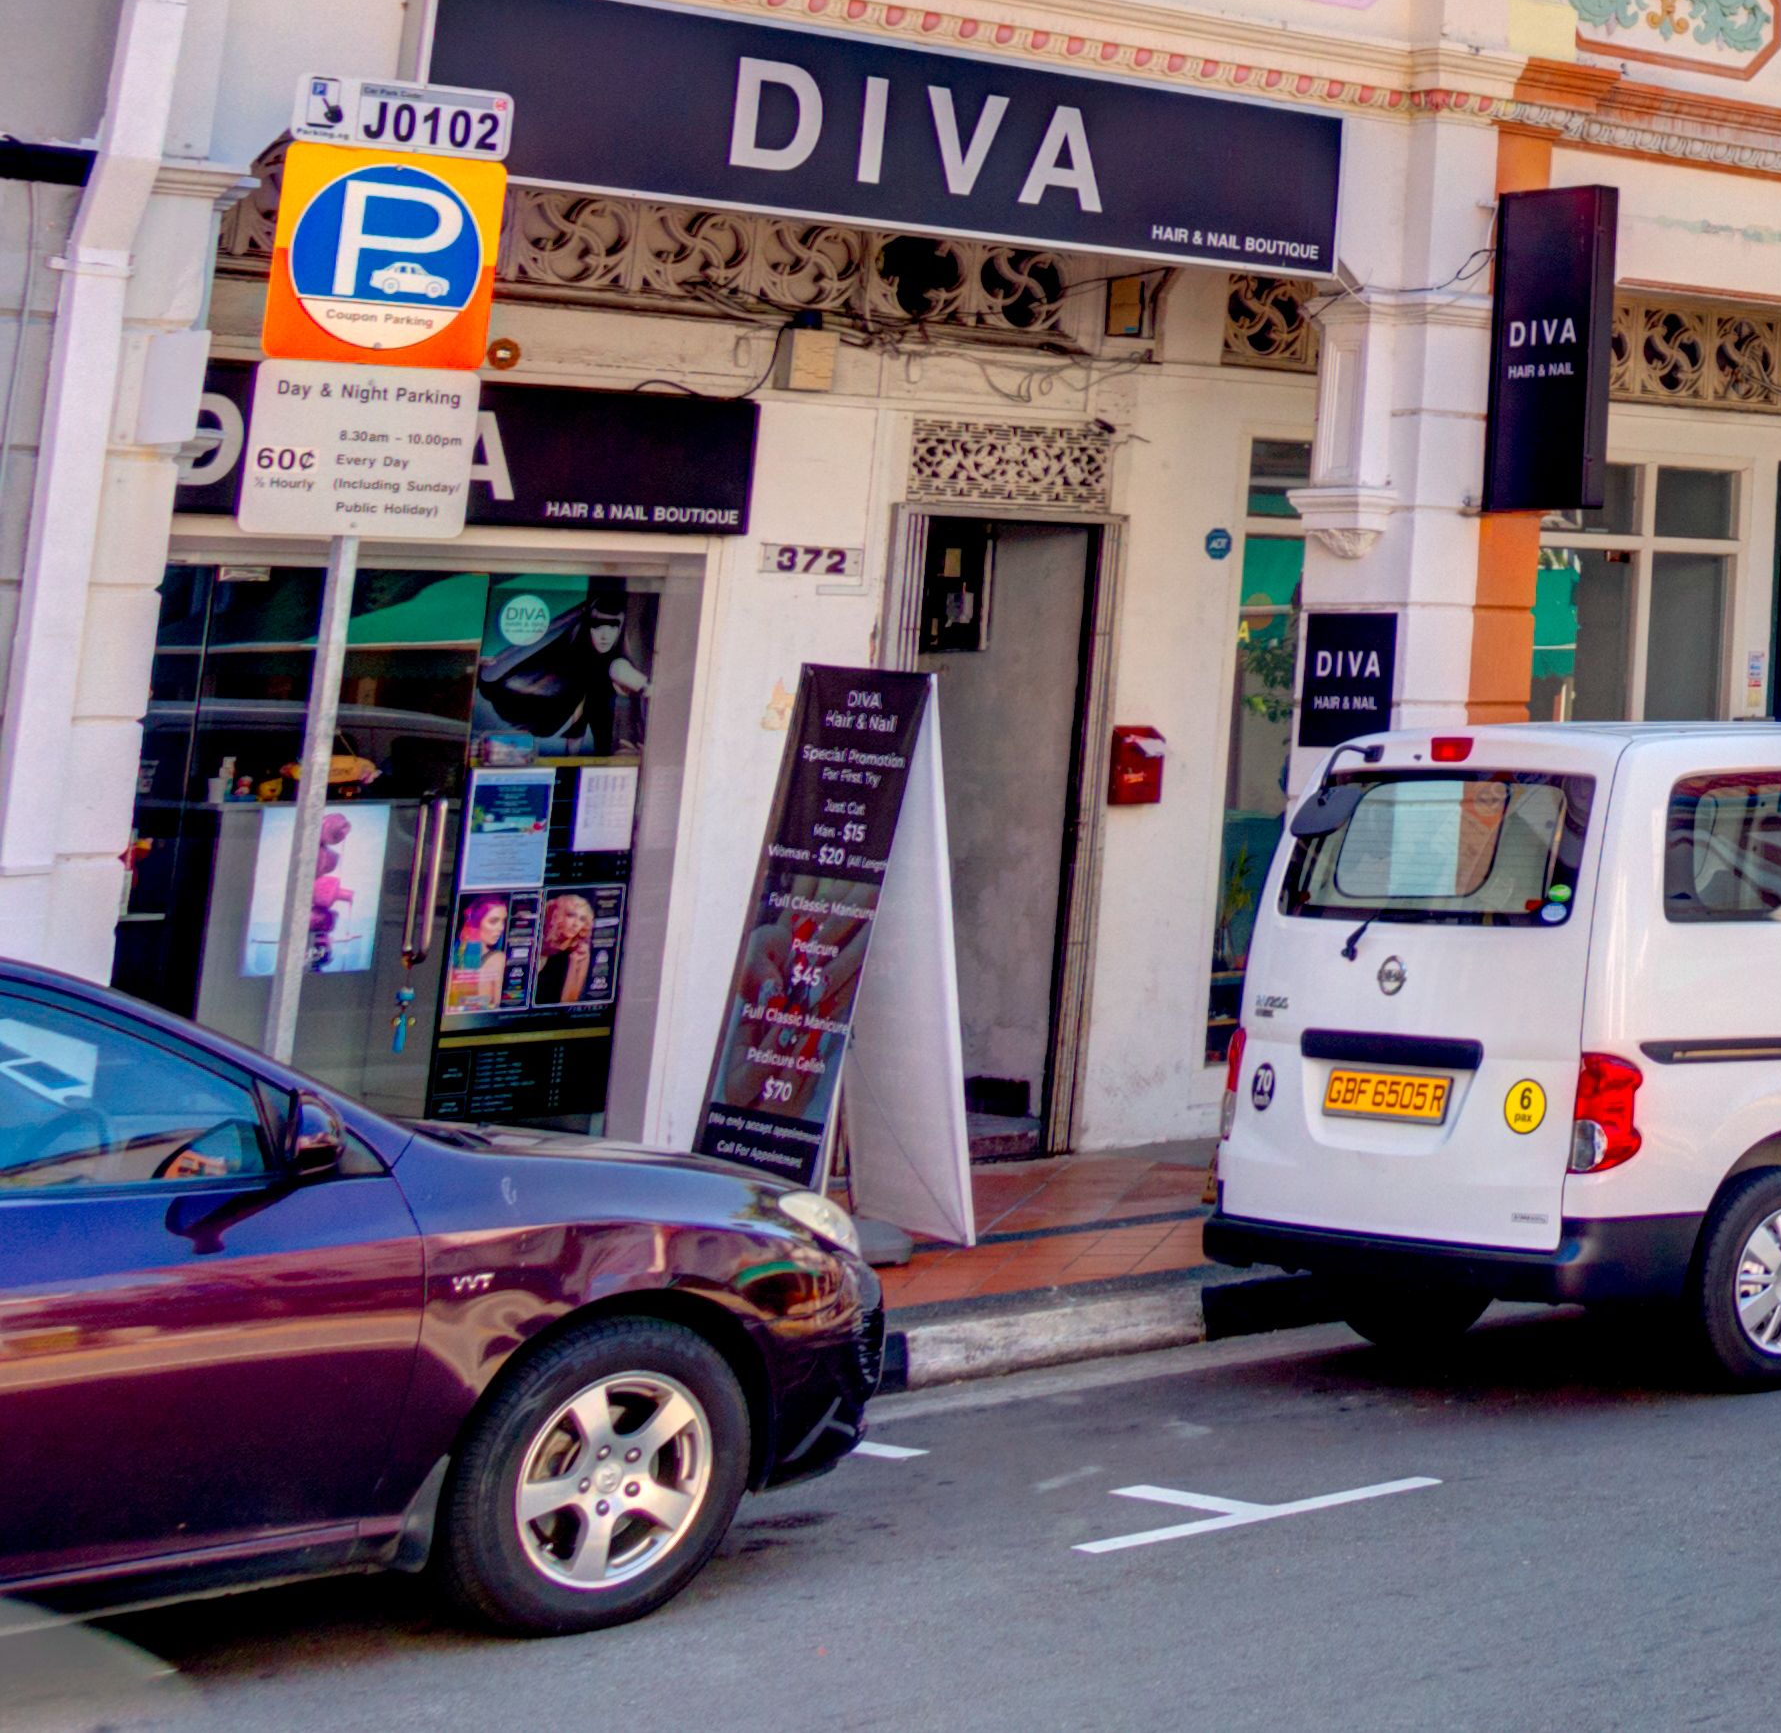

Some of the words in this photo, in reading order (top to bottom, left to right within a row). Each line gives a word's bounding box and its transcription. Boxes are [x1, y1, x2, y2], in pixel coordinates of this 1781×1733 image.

[363, 102, 499, 151] J0102
[728, 56, 1103, 214] DIVA
[332, 180, 464, 296] P
[1151, 225, 1189, 245] HAIR
[1192, 228, 1205, 246] &
[1206, 232, 1241, 253] NAIL
[1244, 236, 1320, 261] BOUTIQUE
[326, 309, 378, 323] Coupon
[384, 314, 434, 329] Parking
[1509, 317, 1577, 347] DIVA
[1508, 364, 1535, 379] HAIR
[1538, 364, 1545, 377] &
[1548, 362, 1574, 376] NAIL
[277, 380, 312, 400] Day
[320, 384, 332, 397] &
[341, 384, 388, 403] Night
[396, 388, 462, 408] Parking
[339, 430, 389, 442] 8.30am
[408, 435, 462, 447] 10.00pm
[256, 447, 315, 471] 60¢
[336, 454, 376, 467] Every
[383, 456, 410, 470] Day
[269, 477, 314, 492] Hourly
[333, 478, 400, 493] (Including
[335, 502, 377, 515] Public
[384, 504, 439, 517] Holiday)
[545, 501, 589, 518] HAIR
[592, 504, 605, 519] &
[608, 504, 648, 521] NAIL
[653, 507, 739, 525] BOUTIQUE
[776, 546, 847, 574] 372
[505, 606, 546, 621] DIVA
[1316, 650, 1381, 678] DIVA
[847, 690, 882, 709] DIVA
[1313, 696, 1340, 710] HAIR
[1342, 696, 1350, 710] &
[1352, 696, 1377, 710] NAIL
[826, 710, 854, 729] Hair
[856, 713, 867, 730] &
[869, 716, 897, 733] Nail
[802, 744, 847, 763] Special
[848, 749, 906, 769] Promotion
[822, 766, 838, 779] For
[866, 772, 882, 789] Try
[824, 799, 846, 814] Just
[848, 800, 866, 815] Cut
[813, 824, 836, 838] Man
[843, 822, 867, 843] $15
[768, 844, 810, 861] Woman
[818, 845, 845, 866] $20
[768, 891, 789, 908] Full
[792, 893, 829, 914] Classic
[832, 898, 876, 920] Manicure
[791, 938, 839, 958] Pedicure
[792, 965, 823, 987] $45
[742, 1003, 763, 1020] Full
[765, 1007, 803, 1027] Classic
[805, 1013, 849, 1036] Manicure
[762, 1076, 793, 1101] $70
[1256, 1069, 1272, 1093] 70
[1328, 1076, 1371, 1105] GBF
[1372, 1080, 1428, 1110] 6505
[1430, 1084, 1445, 1112] R
[1519, 1086, 1533, 1112] 6
[1514, 1111, 1532, 1124] pax
[716, 1139, 734, 1154] Call
[734, 1143, 749, 1158] For
